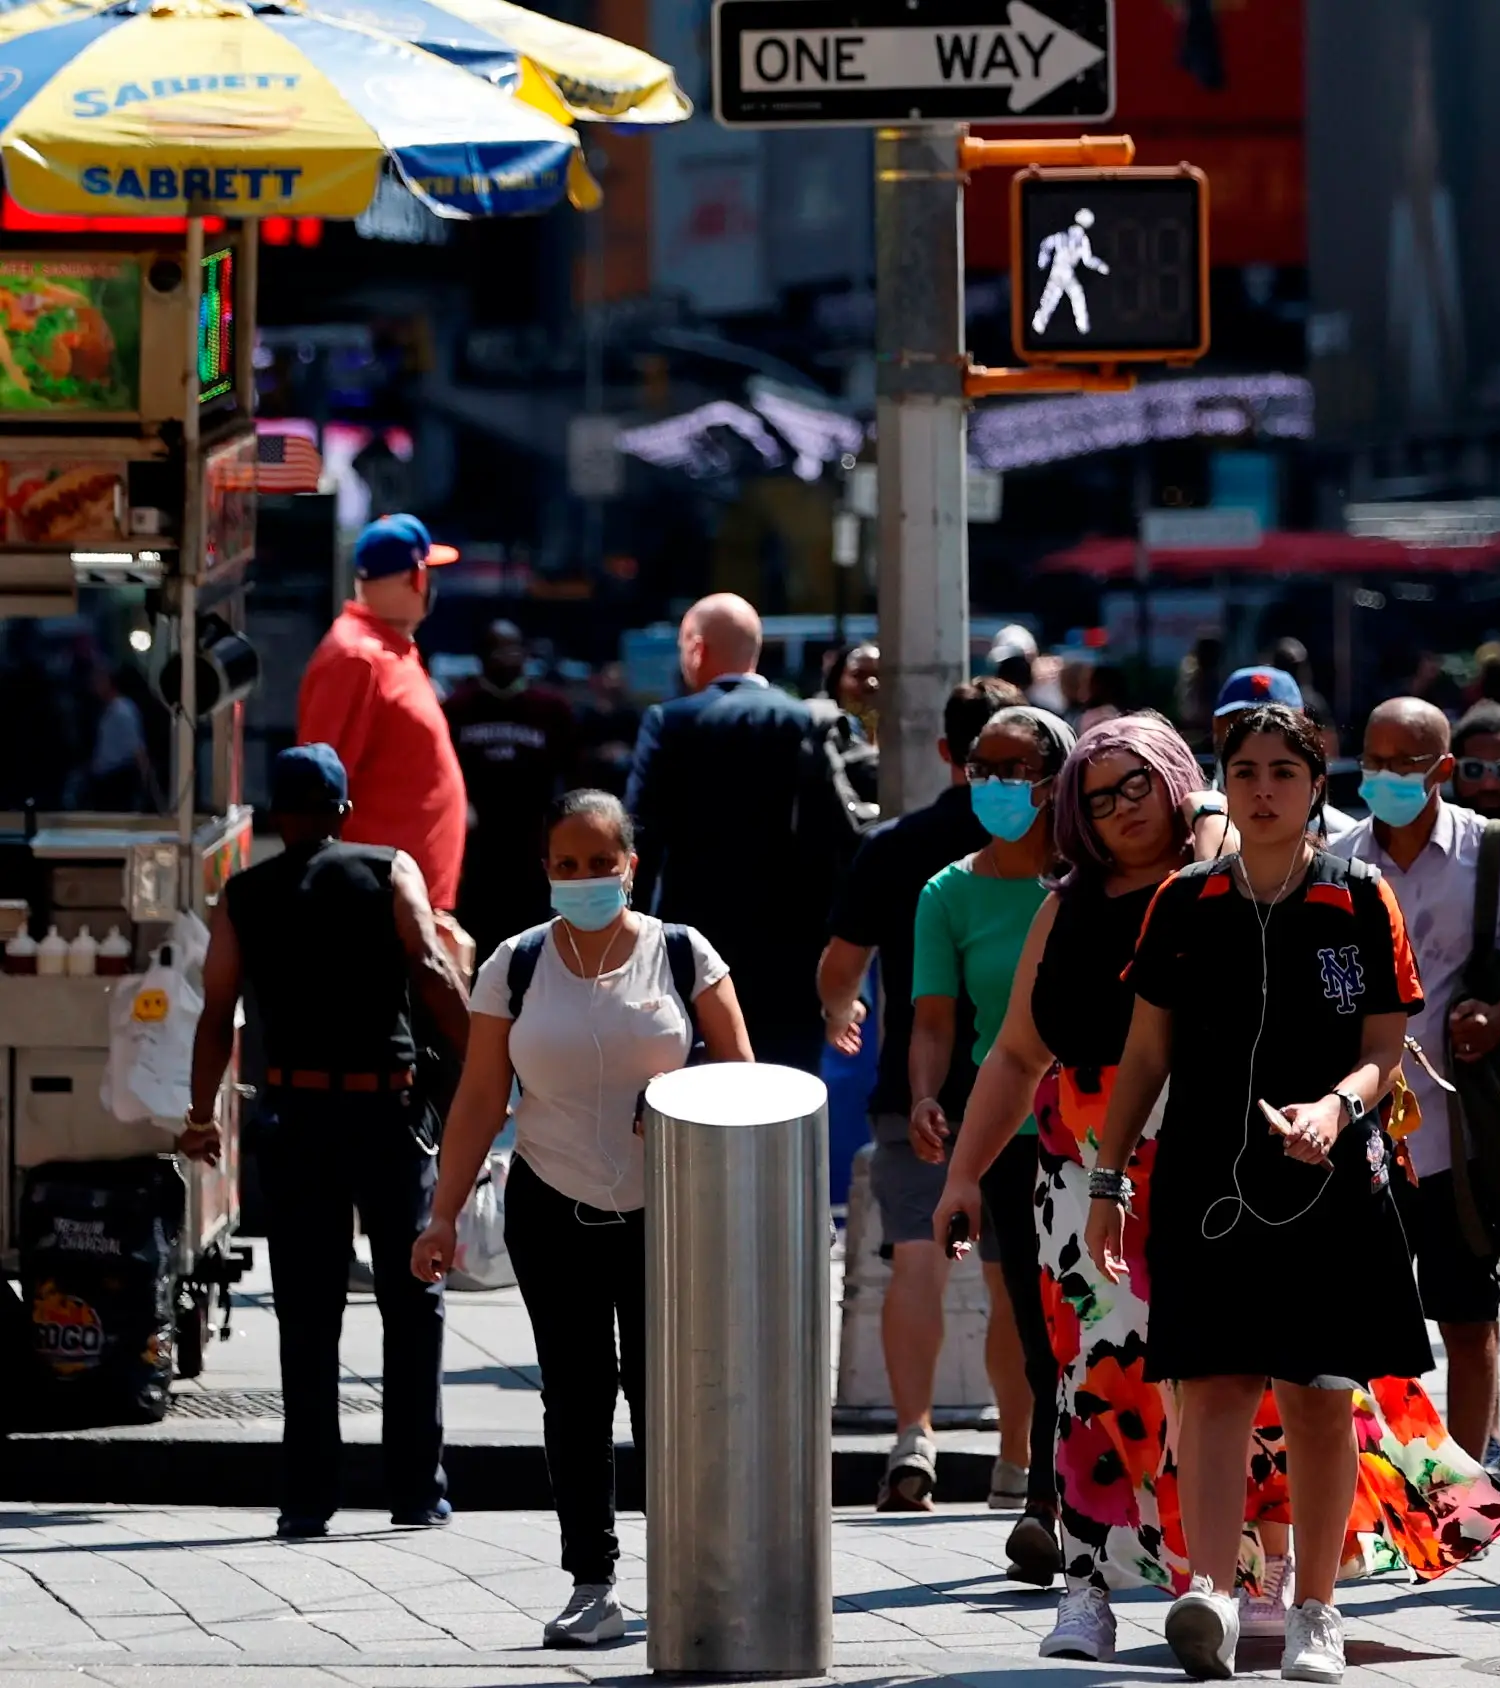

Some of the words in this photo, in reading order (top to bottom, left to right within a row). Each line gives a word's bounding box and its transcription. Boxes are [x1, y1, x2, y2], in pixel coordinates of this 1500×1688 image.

[755, 36, 867, 84] ONE
[935, 32, 1056, 81] WAY
[72, 72, 301, 119] SABRETT
[80, 164, 303, 202] SABRETT
